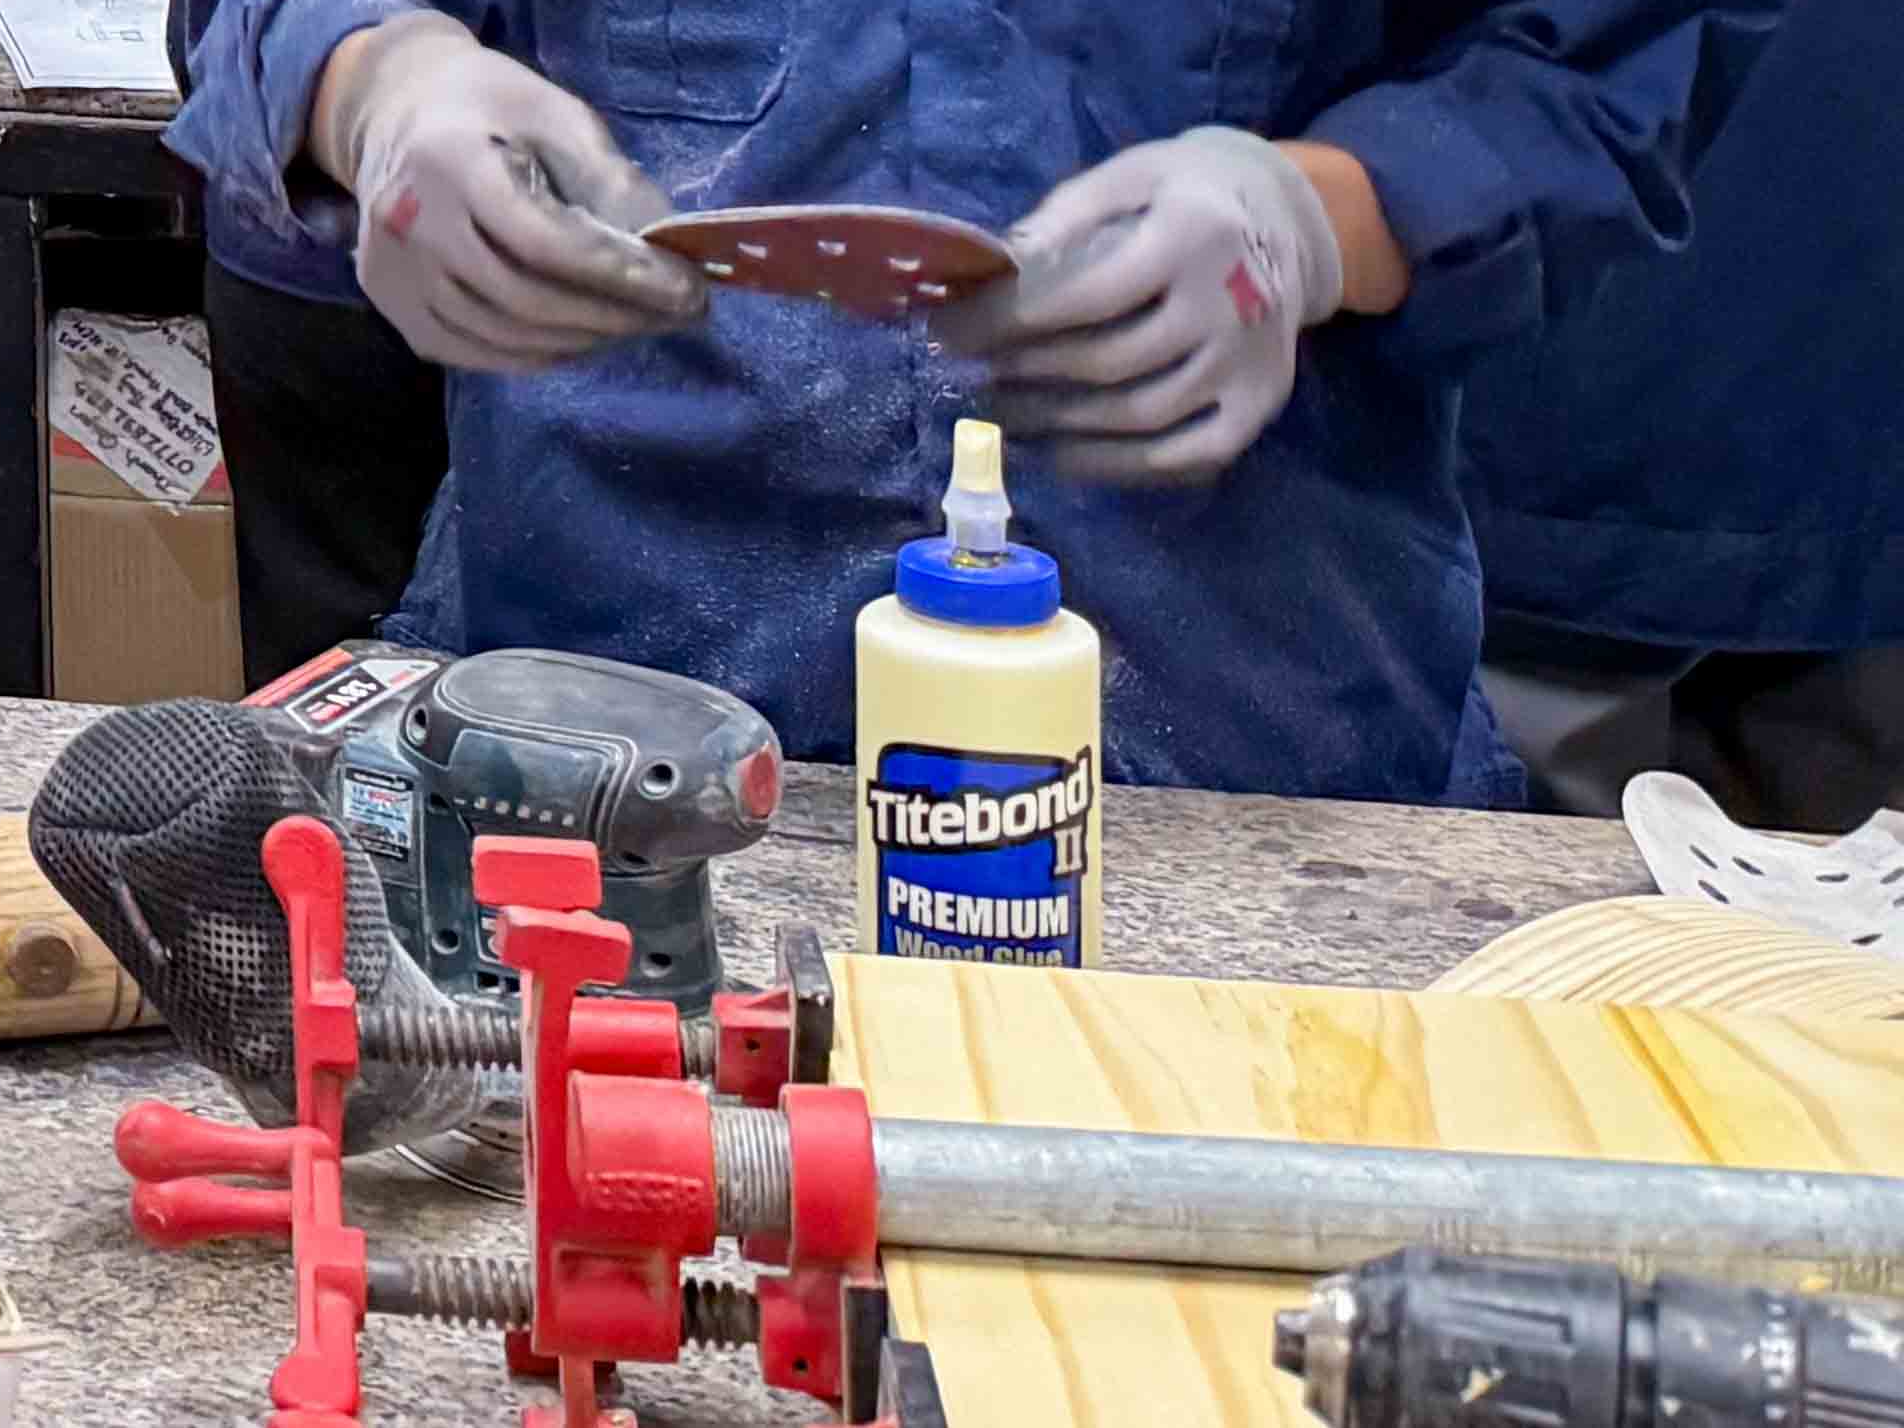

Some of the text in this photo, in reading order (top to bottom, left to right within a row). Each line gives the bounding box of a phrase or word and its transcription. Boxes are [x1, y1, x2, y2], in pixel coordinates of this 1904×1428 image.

[870, 757, 1089, 846] Titebond
[1053, 824, 1083, 876] II
[888, 875, 1070, 939] PREMIUM
